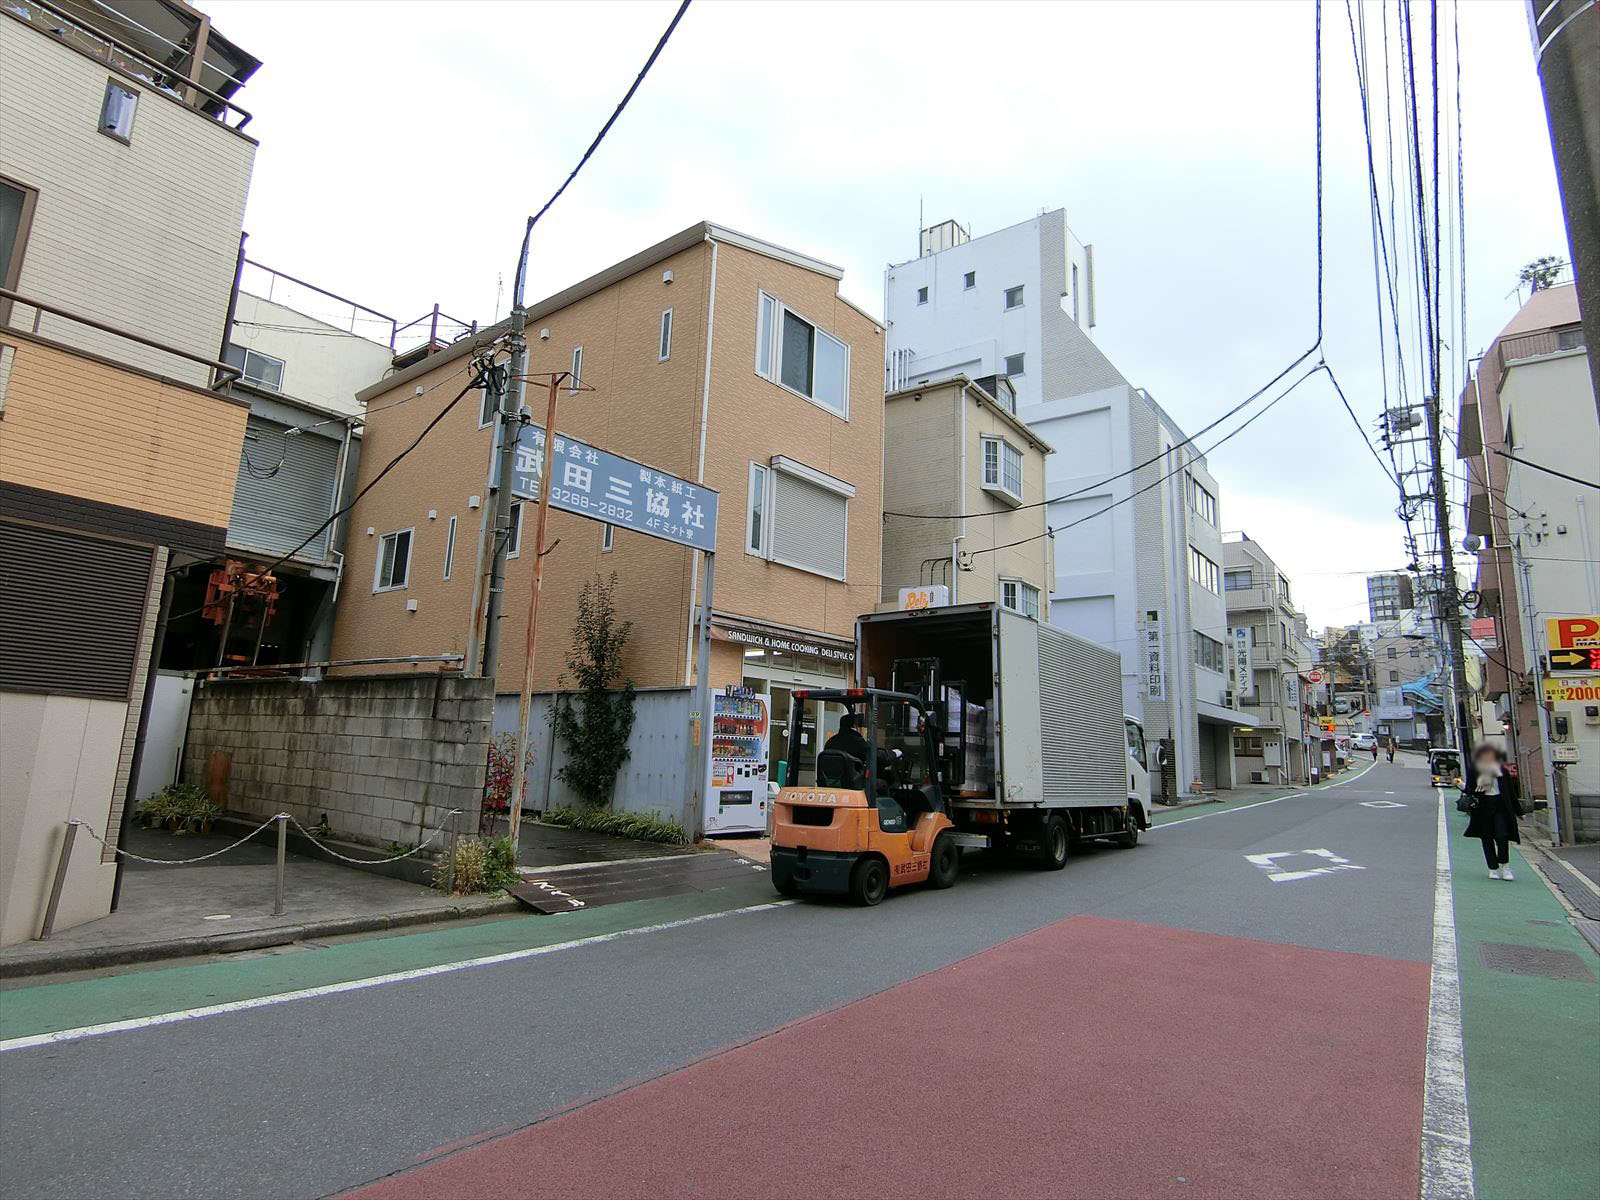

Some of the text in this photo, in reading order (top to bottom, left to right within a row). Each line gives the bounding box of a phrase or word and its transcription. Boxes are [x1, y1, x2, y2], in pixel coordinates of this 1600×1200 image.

[532, 431, 599, 466] 有限会社
[515, 445, 705, 529] 武田三協社
[519, 476, 634, 522] TE 3268-2832
[646, 518, 660, 529] 4F
[728, 630, 763, 645] SANDWICH
[764, 638, 770, 646] &
[771, 638, 790, 650] HOME
[791, 643, 818, 655] COOKING
[821, 648, 833, 658] DELI
[833, 650, 848, 660] STYLE
[1558, 619, 1599, 648] P
[1147, 631, 1161, 696] 第一資料印刷
[783, 791, 837, 804] TOYOTA
